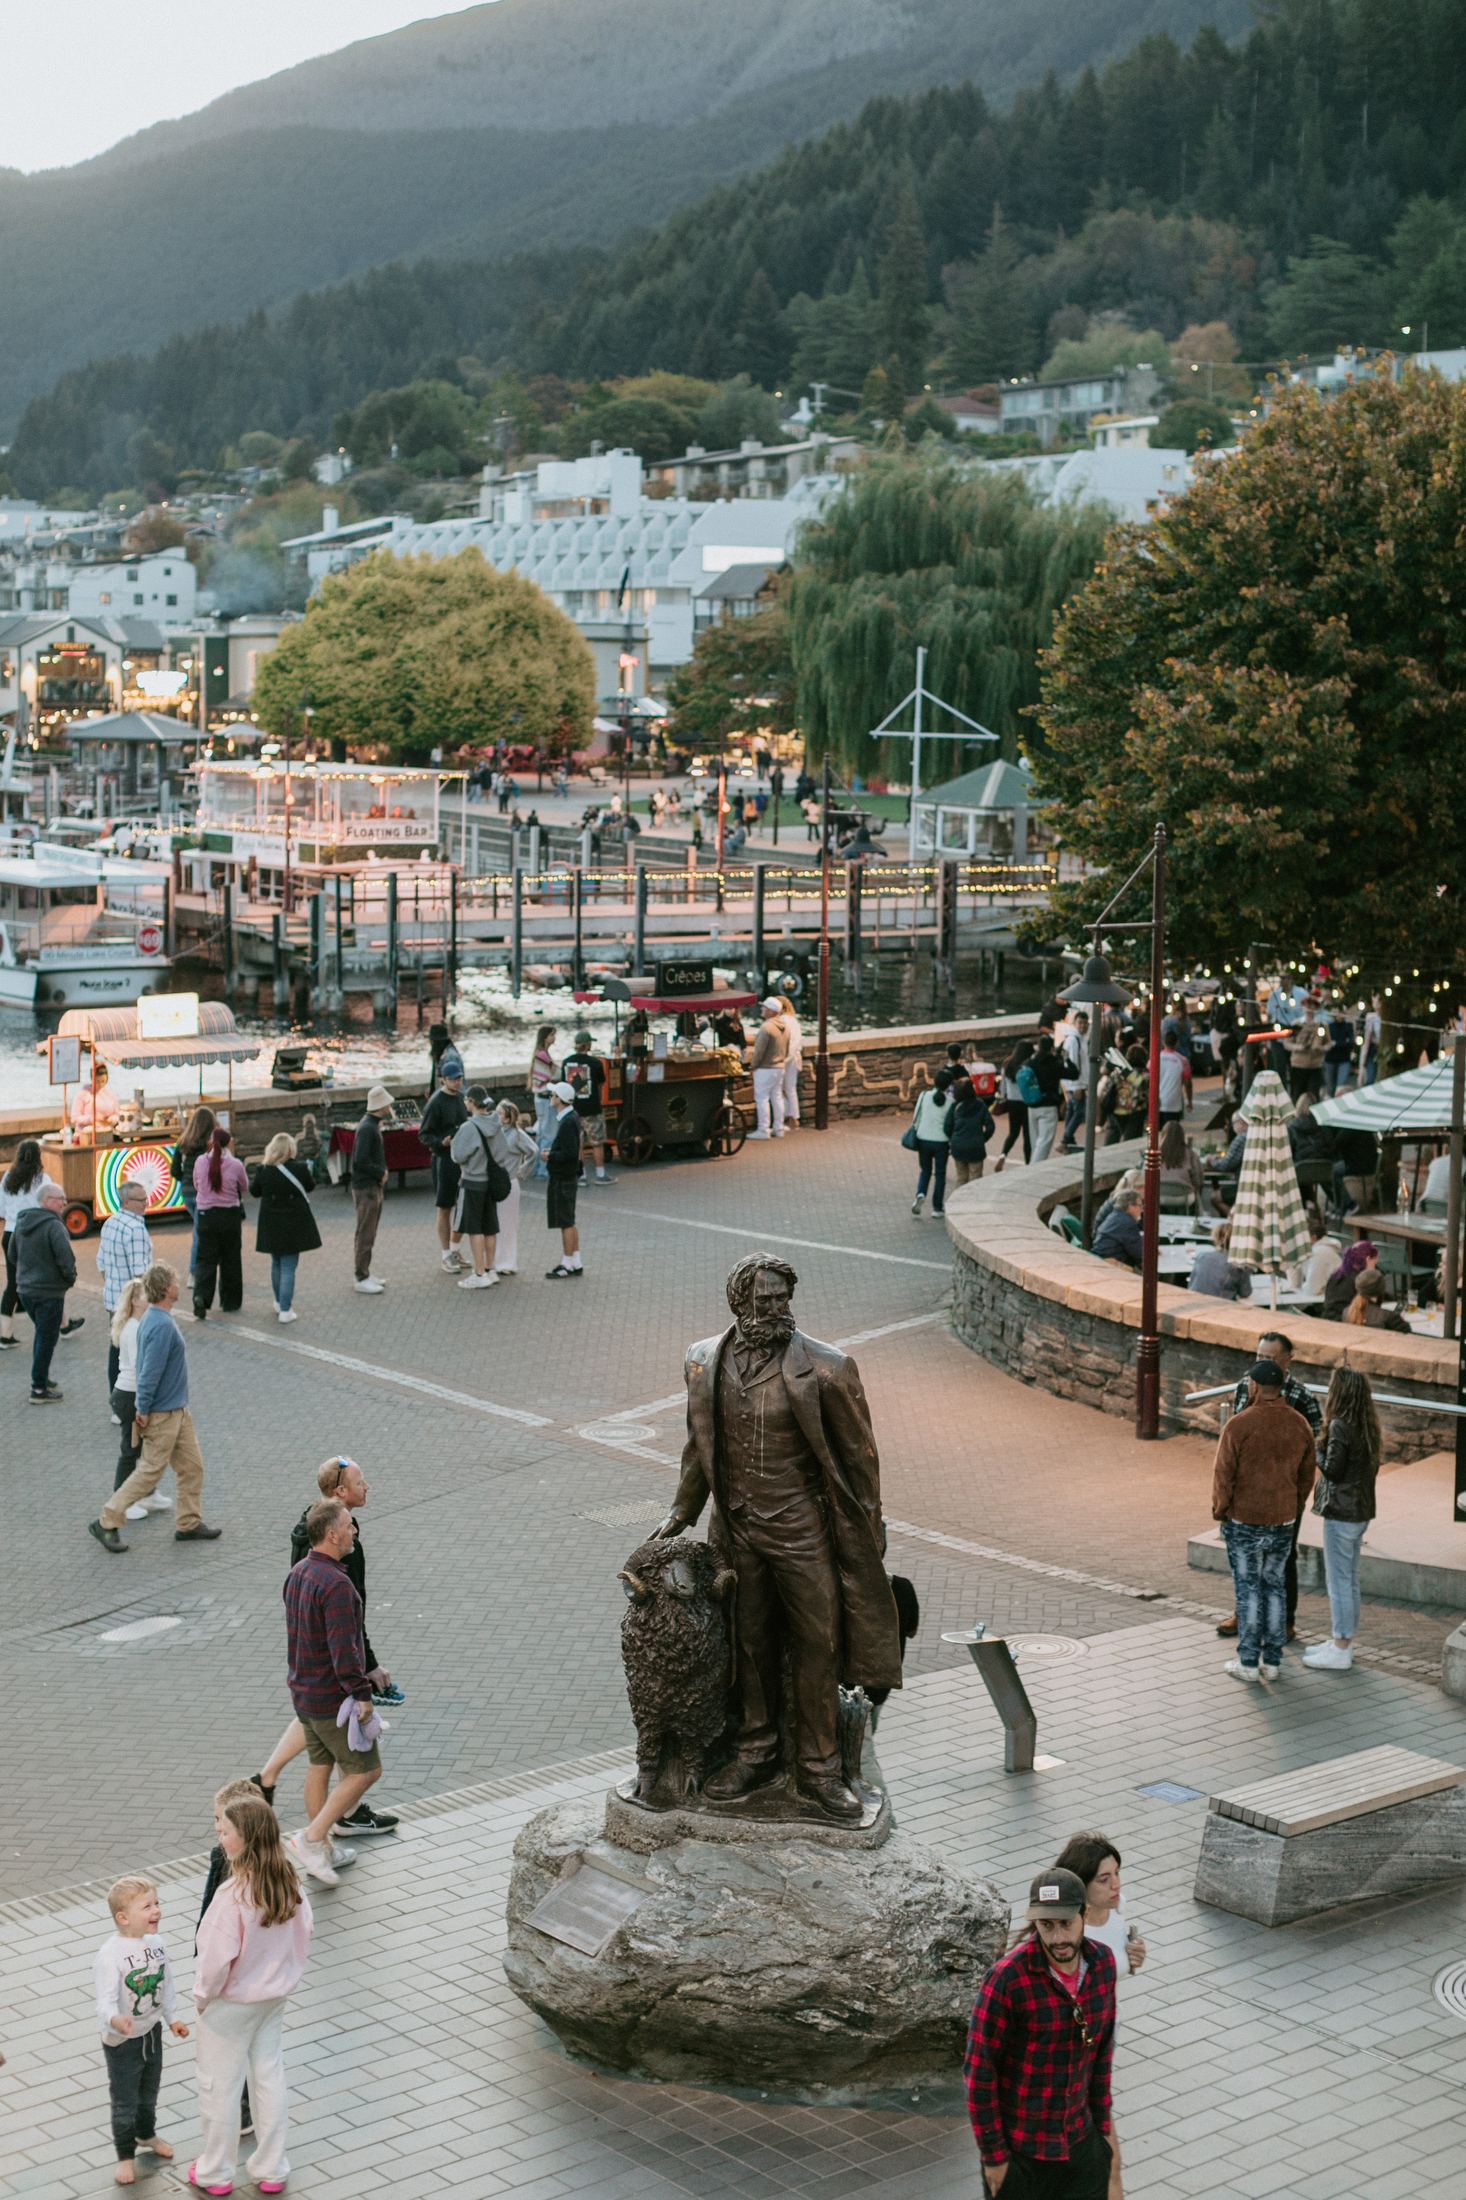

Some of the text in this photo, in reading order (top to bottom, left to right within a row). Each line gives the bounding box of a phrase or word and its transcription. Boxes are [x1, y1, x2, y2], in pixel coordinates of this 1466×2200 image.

[346, 825, 428, 837] FLOATING BAR
[665, 967, 707, 986] Crêpes
